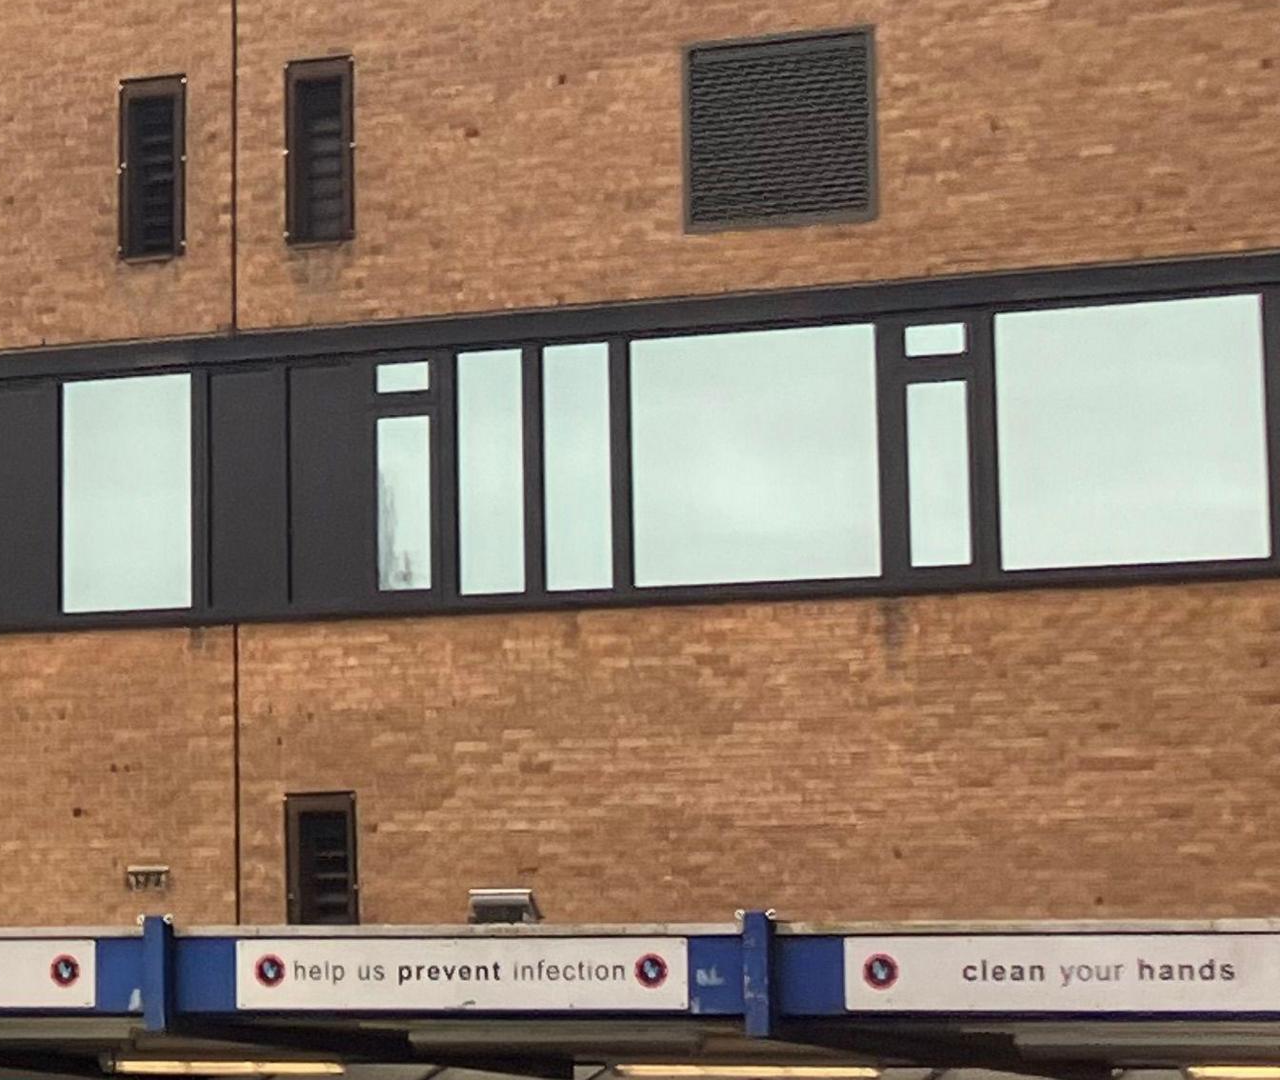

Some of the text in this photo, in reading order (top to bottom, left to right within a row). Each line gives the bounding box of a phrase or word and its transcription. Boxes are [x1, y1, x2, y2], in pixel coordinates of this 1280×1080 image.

[293, 959, 627, 986] help us prevent infection
[962, 959, 1237, 987] clean your hands
